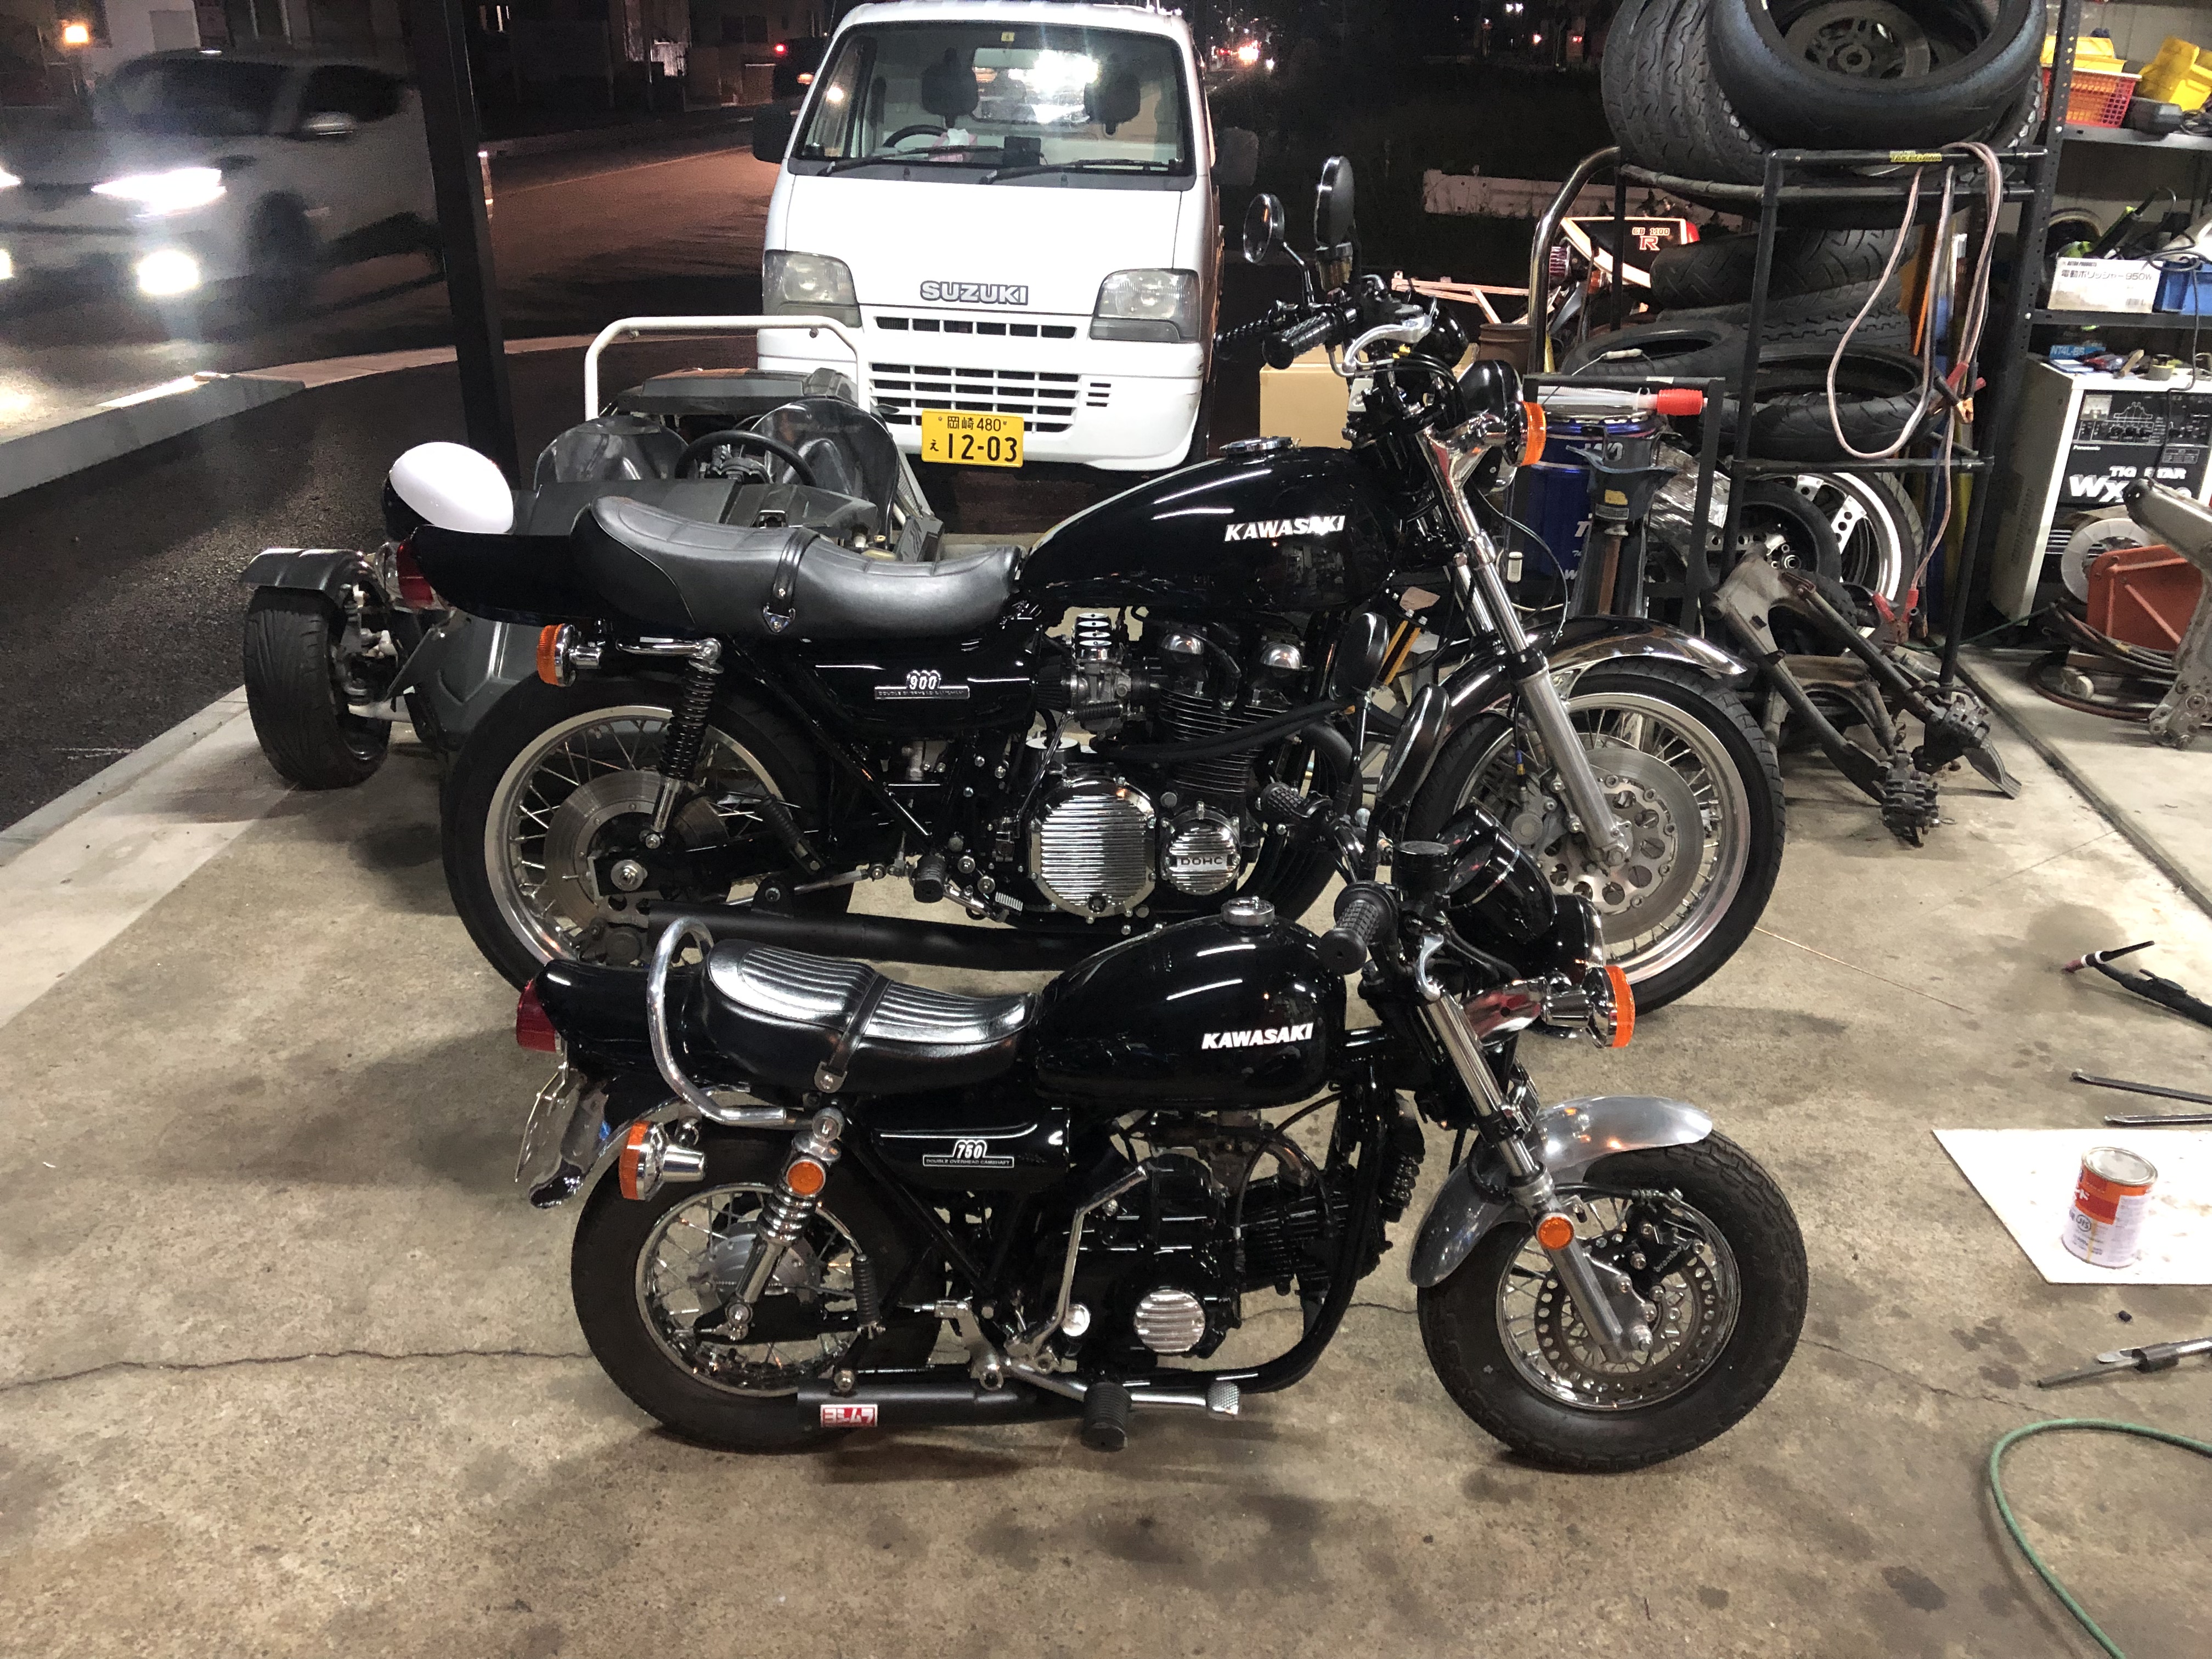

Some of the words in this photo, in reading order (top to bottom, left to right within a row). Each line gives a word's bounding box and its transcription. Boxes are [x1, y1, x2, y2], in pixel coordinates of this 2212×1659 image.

[1639, 235, 1660, 251] R
[920, 280, 1028, 306] SUZUKI
[930, 439, 939, 452] え
[949, 433, 1017, 462] 12-03
[2109, 466, 2137, 477] TIG
[1224, 515, 1345, 542] KAWASAKI
[909, 675, 938, 690] 900
[1181, 856, 1223, 865] DOHC
[1201, 1022, 1314, 1050] KAWASAKI
[957, 1145, 983, 1159] 750
[1653, 1246, 1682, 1272] brembo
